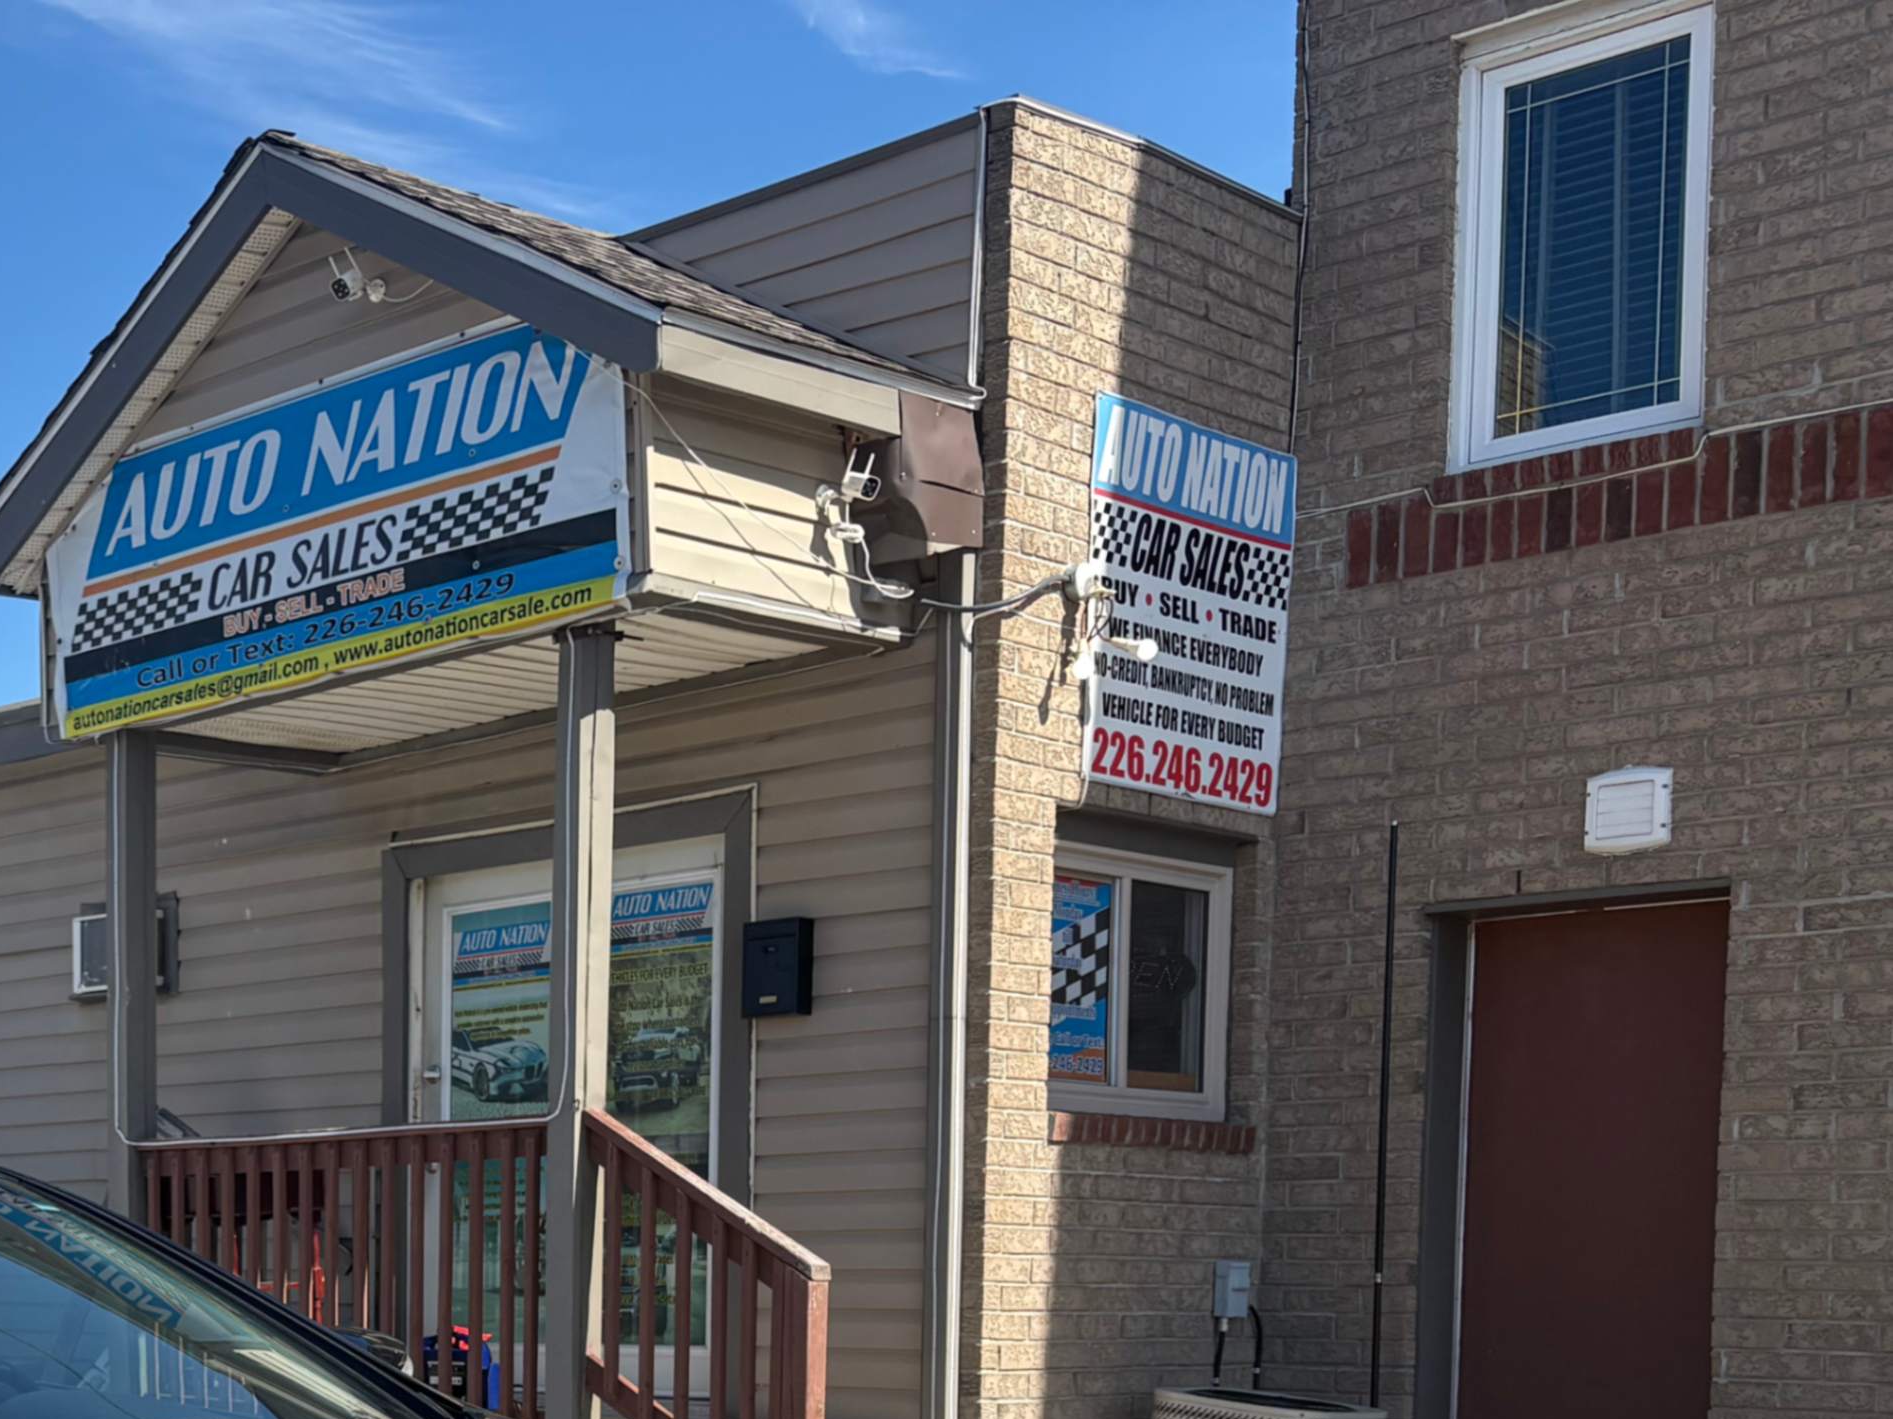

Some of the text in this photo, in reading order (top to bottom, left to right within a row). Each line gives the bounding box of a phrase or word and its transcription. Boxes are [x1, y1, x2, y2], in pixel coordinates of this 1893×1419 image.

[105, 341, 576, 557] AUTO NATION
[1098, 406, 1287, 534] AUTO NATION
[207, 513, 399, 611] CAR SALES
[1130, 513, 1250, 601] CAR SALES
[137, 572, 514, 689] Call or Text: 226-246-2429
[223, 568, 405, 638] BUY SELL TRADE
[1159, 591, 1199, 624] SELL
[1219, 608, 1277, 644] TRADE
[73, 584, 592, 731] autonationcarsales@gmail.com www.autonationcarsale.com
[1094, 651, 1274, 717] NO-CREDIT, BANKRUPTCY, NO PROBLEM
[1109, 617, 1130, 640] WE
[1190, 637, 1263, 677] EVERYBODY
[1102, 691, 1265, 751] VEHICLE FOR EVERY BUDGET
[1091, 726, 1273, 808] 226.246.2429
[461, 922, 547, 952] AUTO NATION
[613, 886, 709, 918] AUTO NATION
